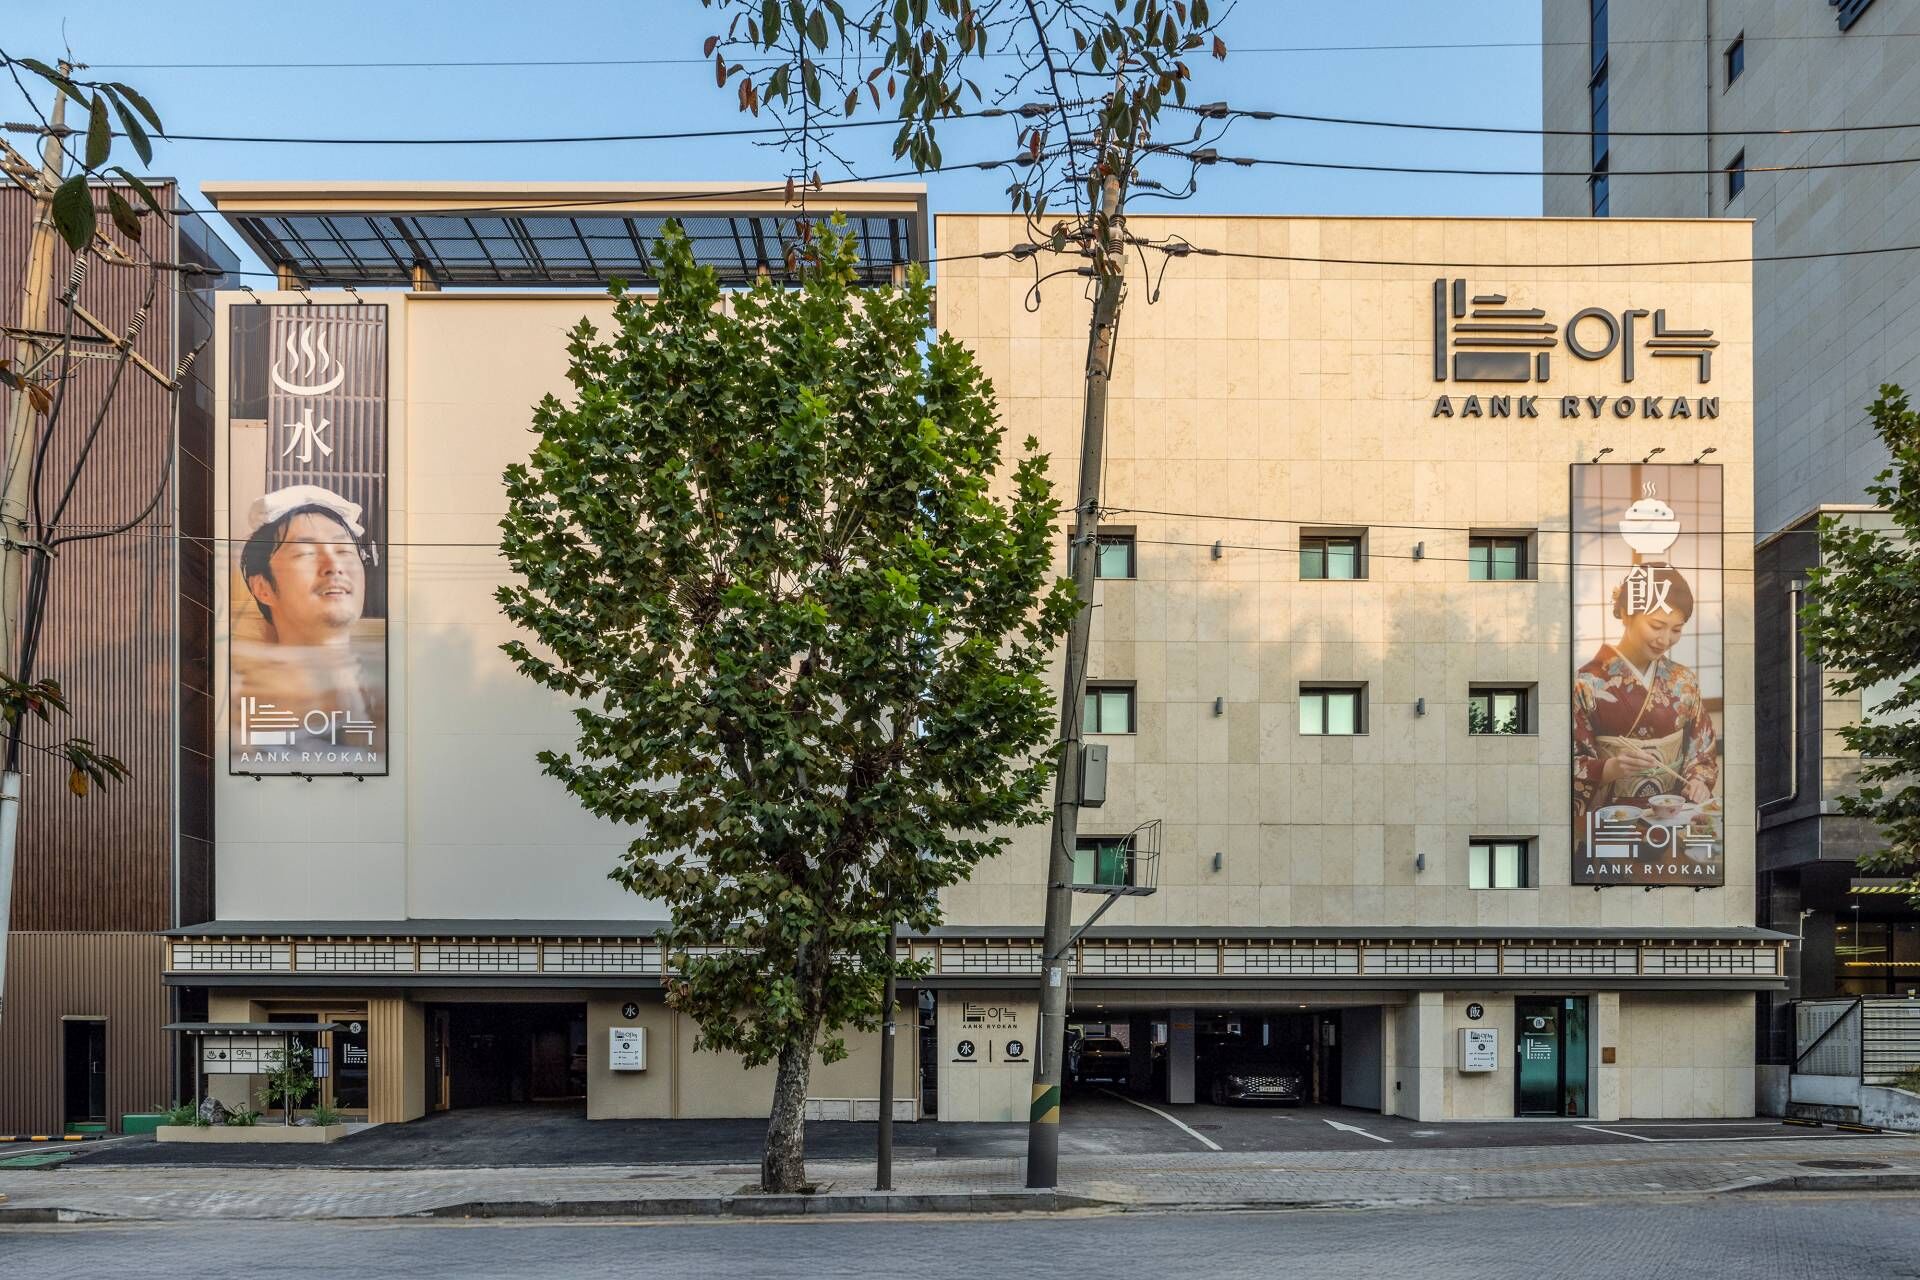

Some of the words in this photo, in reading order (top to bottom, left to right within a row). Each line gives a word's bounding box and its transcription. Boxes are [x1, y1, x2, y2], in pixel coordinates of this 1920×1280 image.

[1433, 394, 1539, 418] AANK
[1560, 395, 1720, 419] RYOKAN
[281, 408, 334, 463] 水
[1625, 564, 1674, 616] 飯
[240, 752, 291, 763] AANK
[301, 752, 378, 763] RYOKAN
[1585, 864, 1634, 875] AANK
[1643, 864, 1717, 875] RYOKAN
[624, 1004, 636, 1017] 水
[960, 1042, 972, 1055] 水
